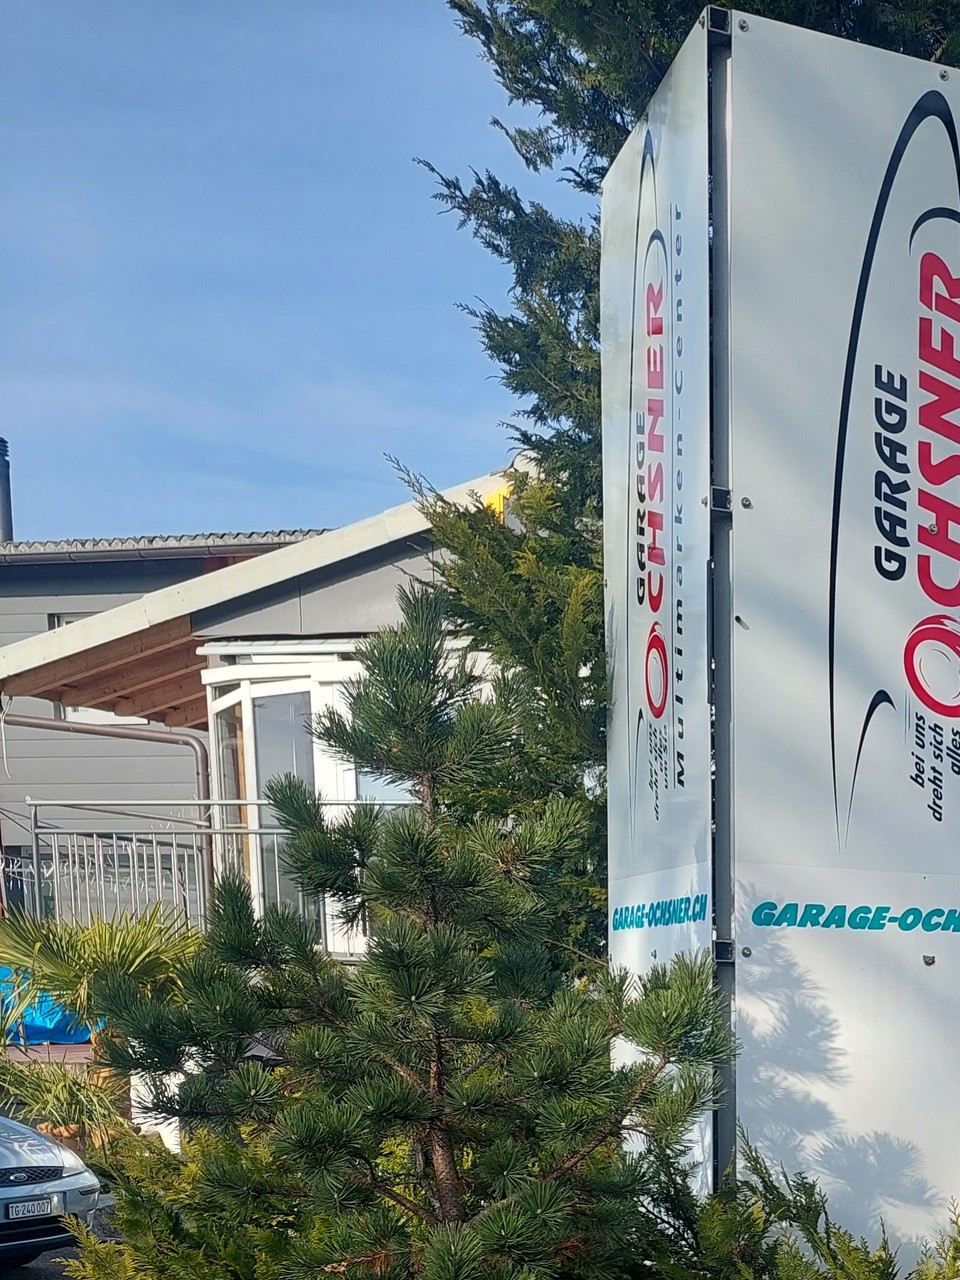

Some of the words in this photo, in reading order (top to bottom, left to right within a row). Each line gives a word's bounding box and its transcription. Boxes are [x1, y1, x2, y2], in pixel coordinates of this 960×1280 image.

[645, 280, 668, 719] OCHSNER
[674, 204, 685, 788] Multimarken-Center
[874, 365, 910, 582] GARAGE
[635, 411, 646, 605] GARAGE
[915, 711, 926, 750] uns
[928, 723, 944, 763] sich
[910, 751, 925, 789] bei
[927, 766, 943, 822] dreht
[612, 894, 708, 931] GARAGE-OCHSNER.CH
